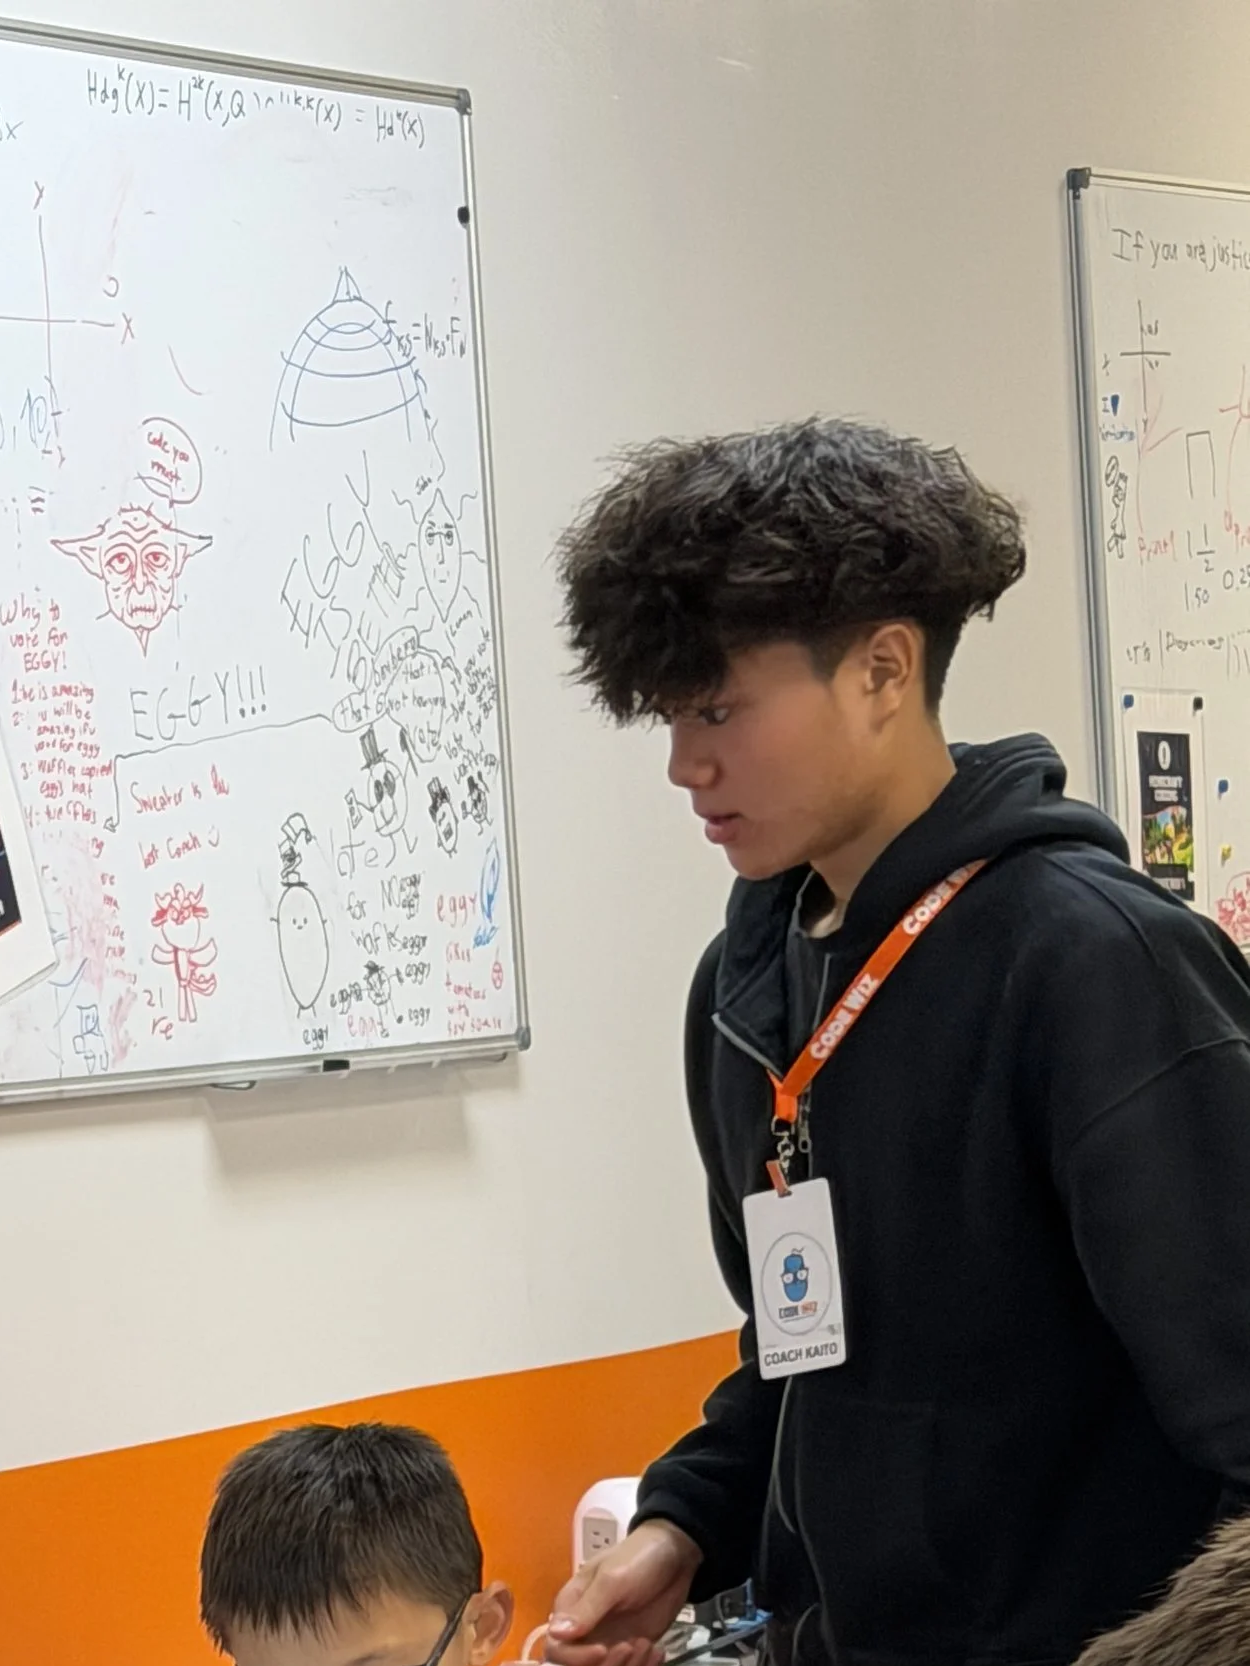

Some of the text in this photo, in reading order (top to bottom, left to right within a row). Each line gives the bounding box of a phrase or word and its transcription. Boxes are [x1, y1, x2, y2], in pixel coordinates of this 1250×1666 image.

[1111, 228, 1144, 262] If
[1150, 240, 1178, 269] you
[1209, 235, 1250, 272] justic
[0, 591, 41, 633] Why
[23, 649, 68, 674] EGGY!
[129, 664, 267, 742] EGGY!!!
[903, 879, 955, 936] CODE
[810, 1008, 854, 1061] CODE
[764, 1342, 839, 1367] COACH KAITO
